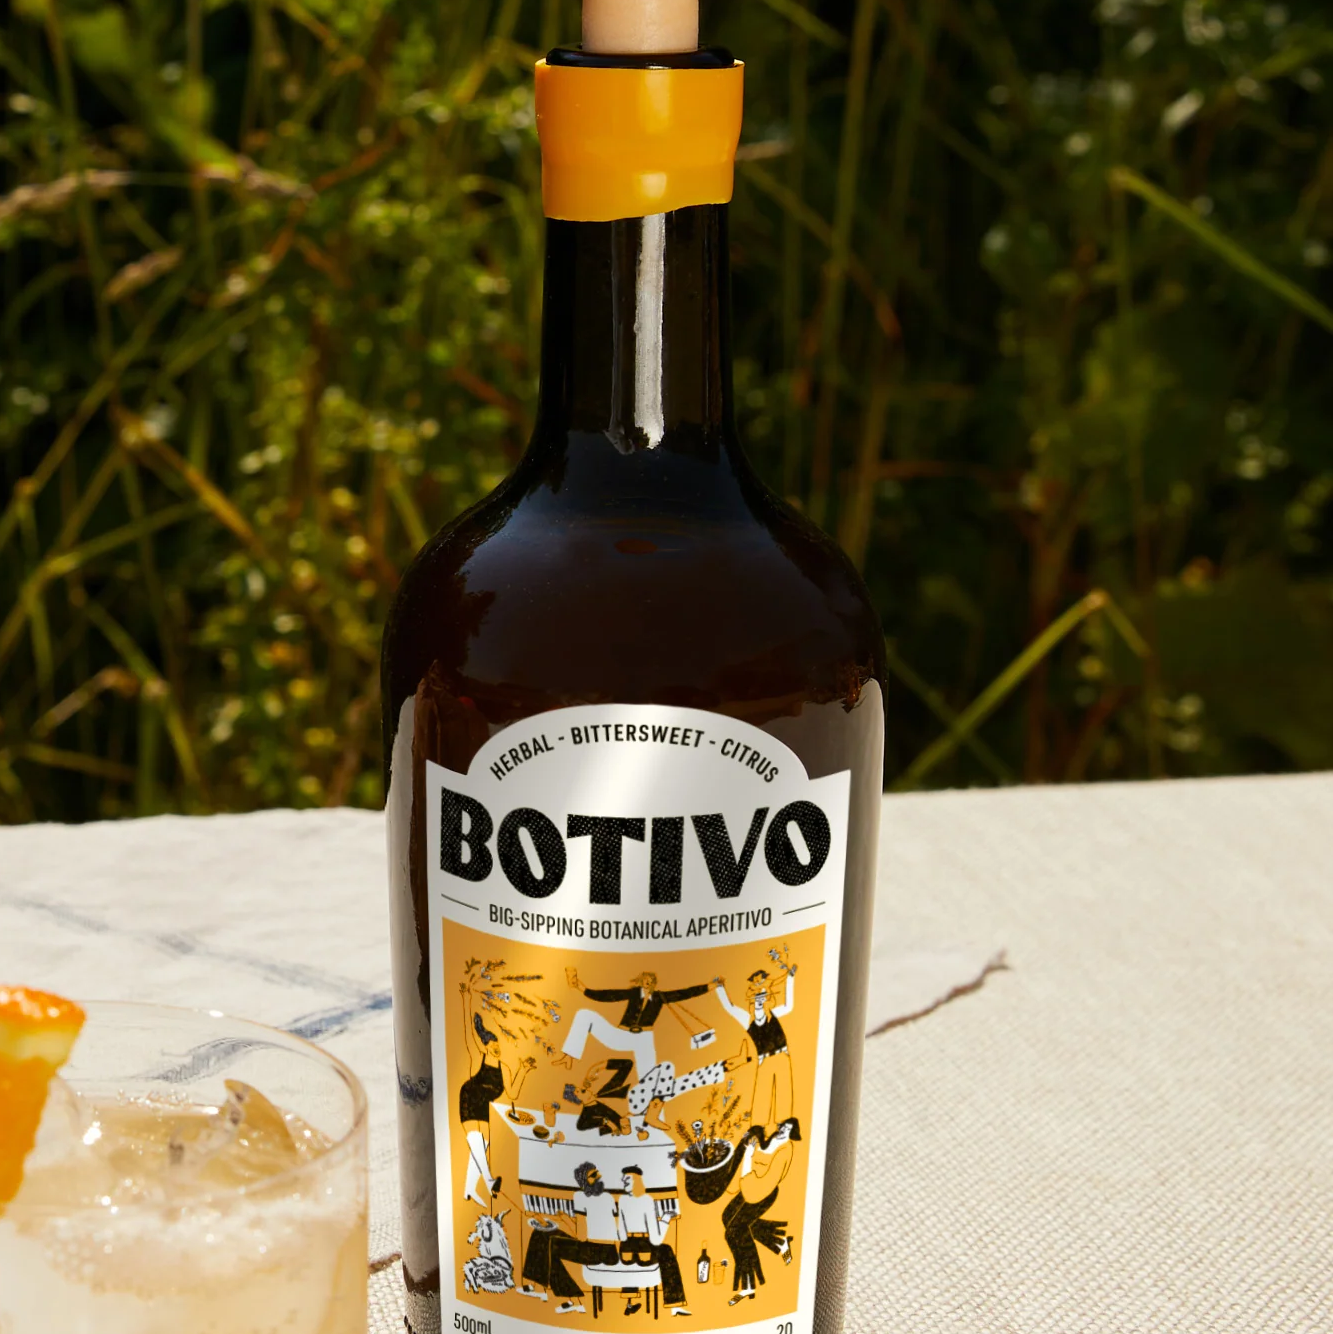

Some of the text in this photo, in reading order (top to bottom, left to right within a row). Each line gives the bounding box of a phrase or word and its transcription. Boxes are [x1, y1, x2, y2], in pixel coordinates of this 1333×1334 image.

[489, 733, 555, 782] HERBAL
[570, 723, 705, 748] BITTERSWEET
[720, 738, 780, 783] CITRUS
[440, 786, 832, 905] BOTIVO
[488, 904, 773, 940] BIG-SIPPING BOTANICAL APERITIVO
